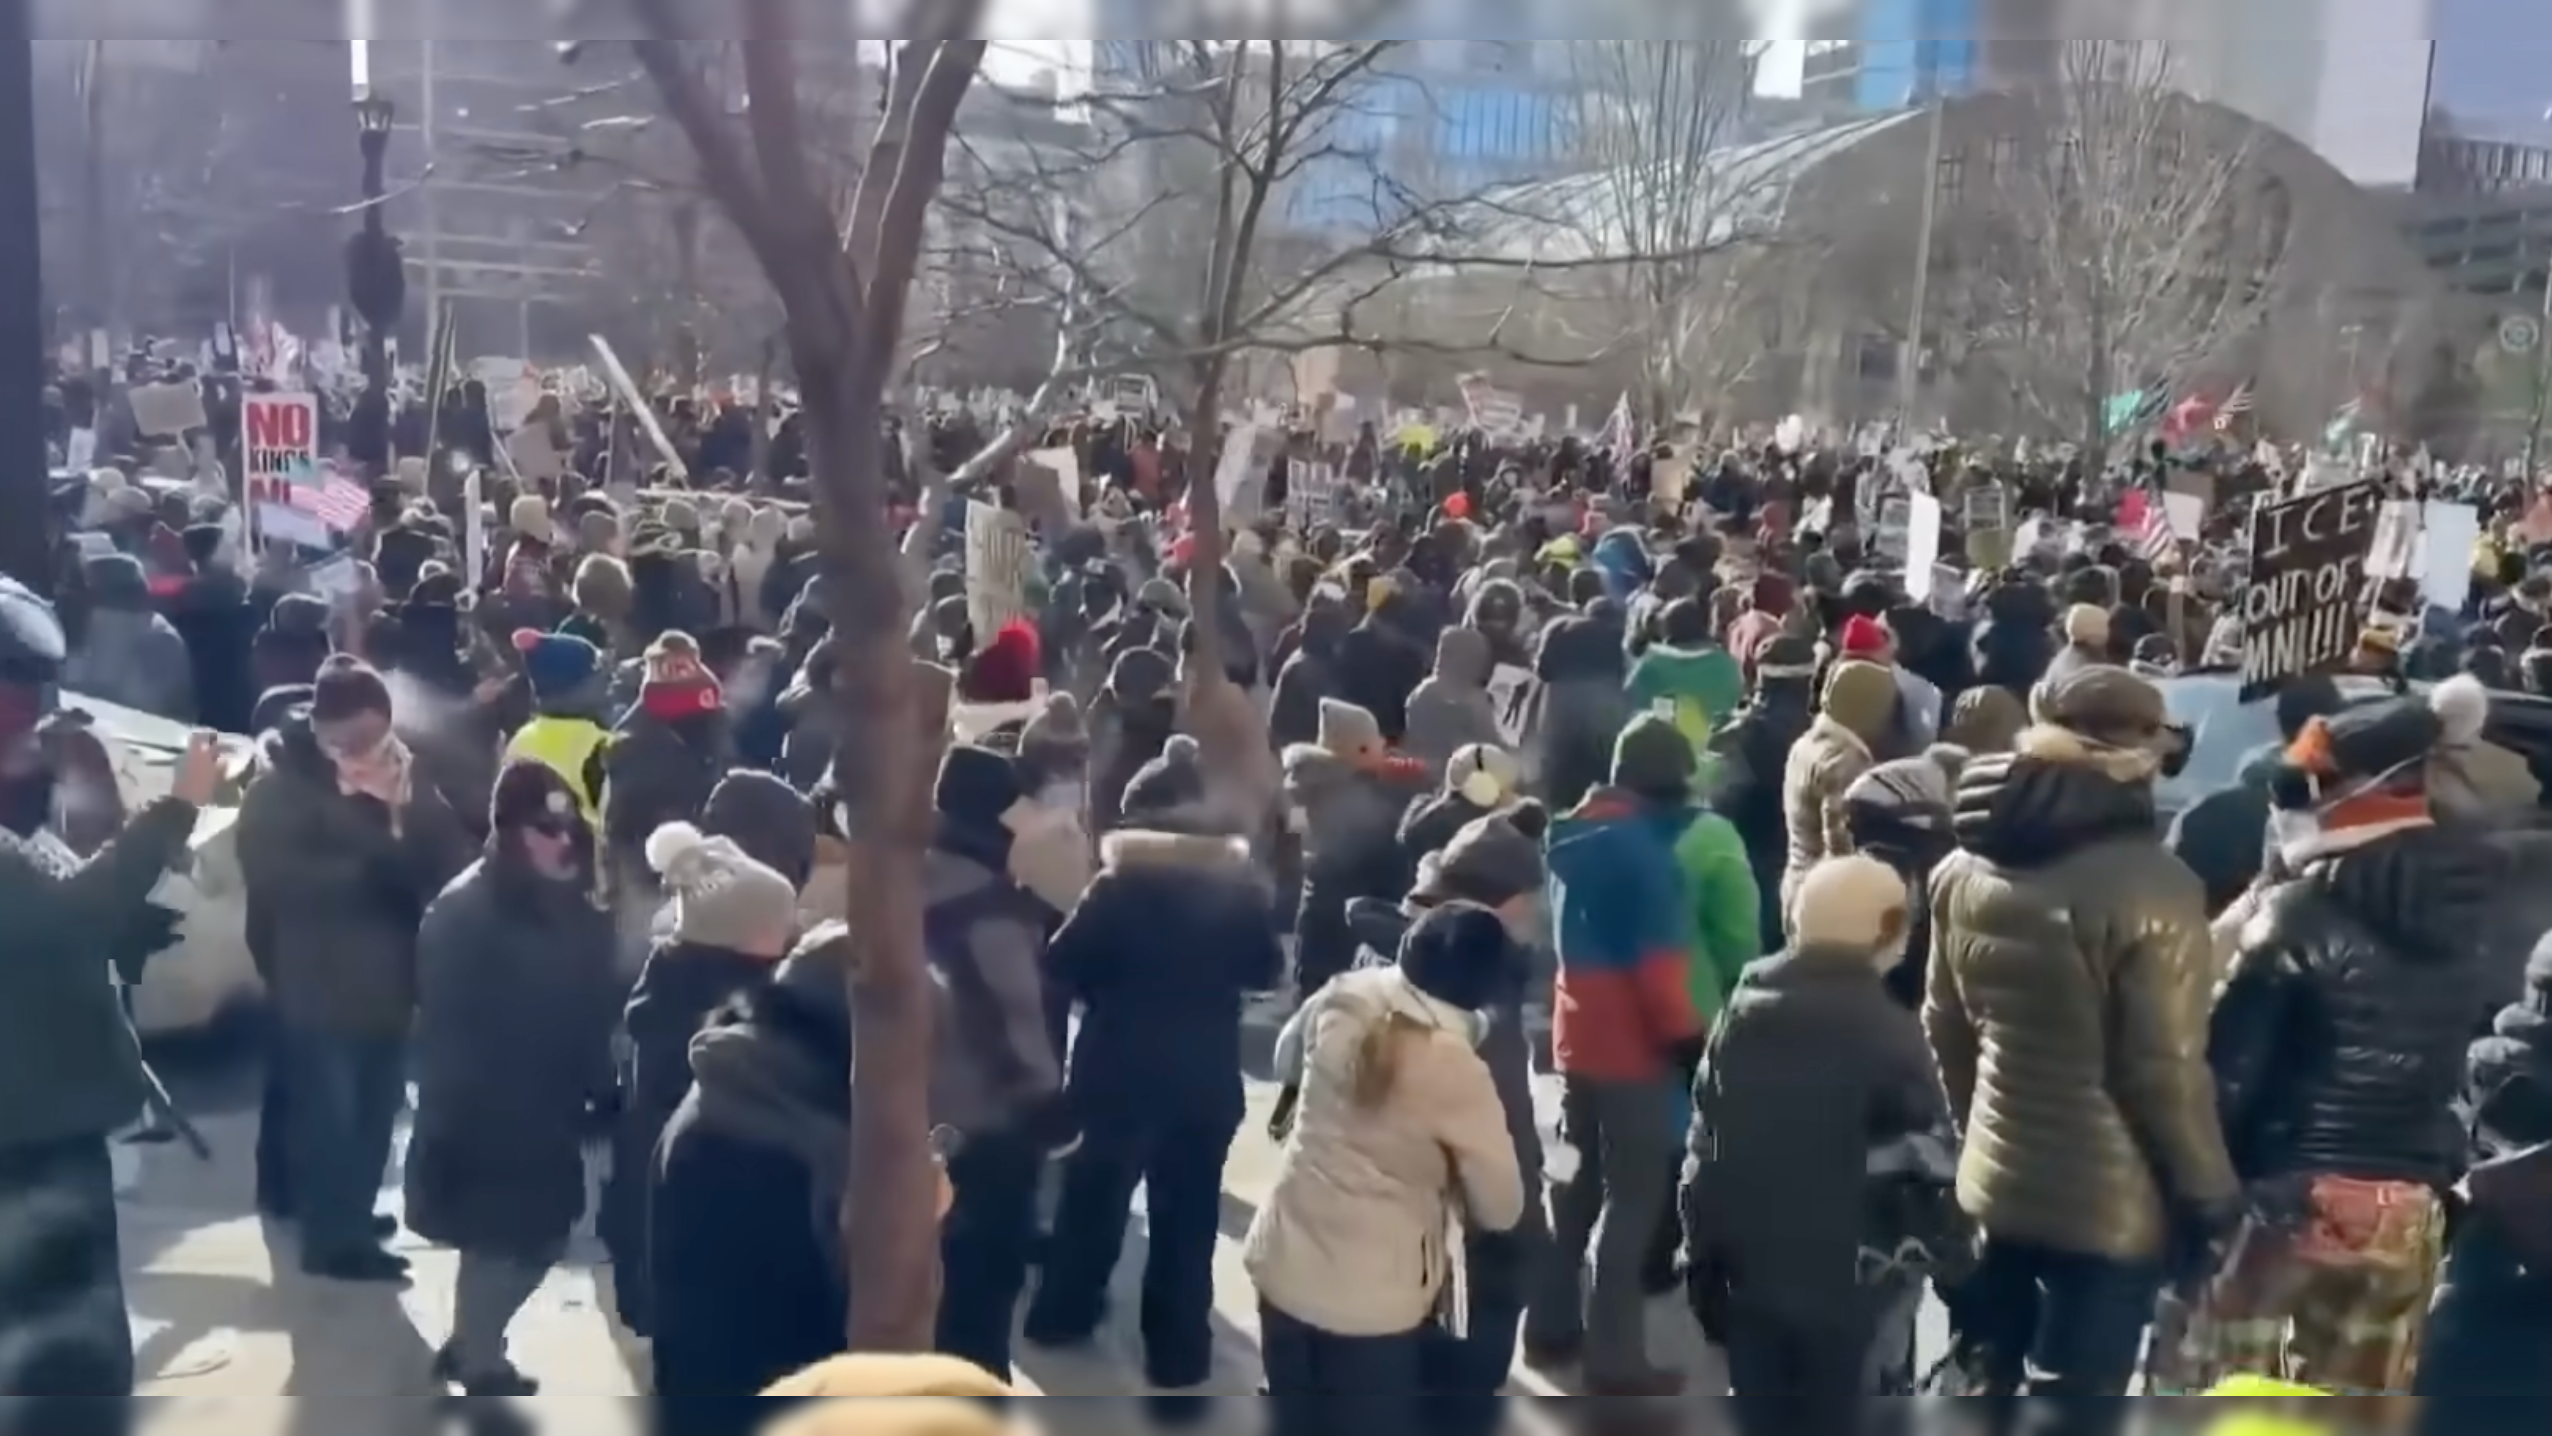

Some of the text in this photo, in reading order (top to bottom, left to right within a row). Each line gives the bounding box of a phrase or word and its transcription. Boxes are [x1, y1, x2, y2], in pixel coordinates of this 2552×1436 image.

[247, 403, 311, 447] NO
[2263, 485, 2370, 558] ICE
[2247, 556, 2358, 624] OUT OF
